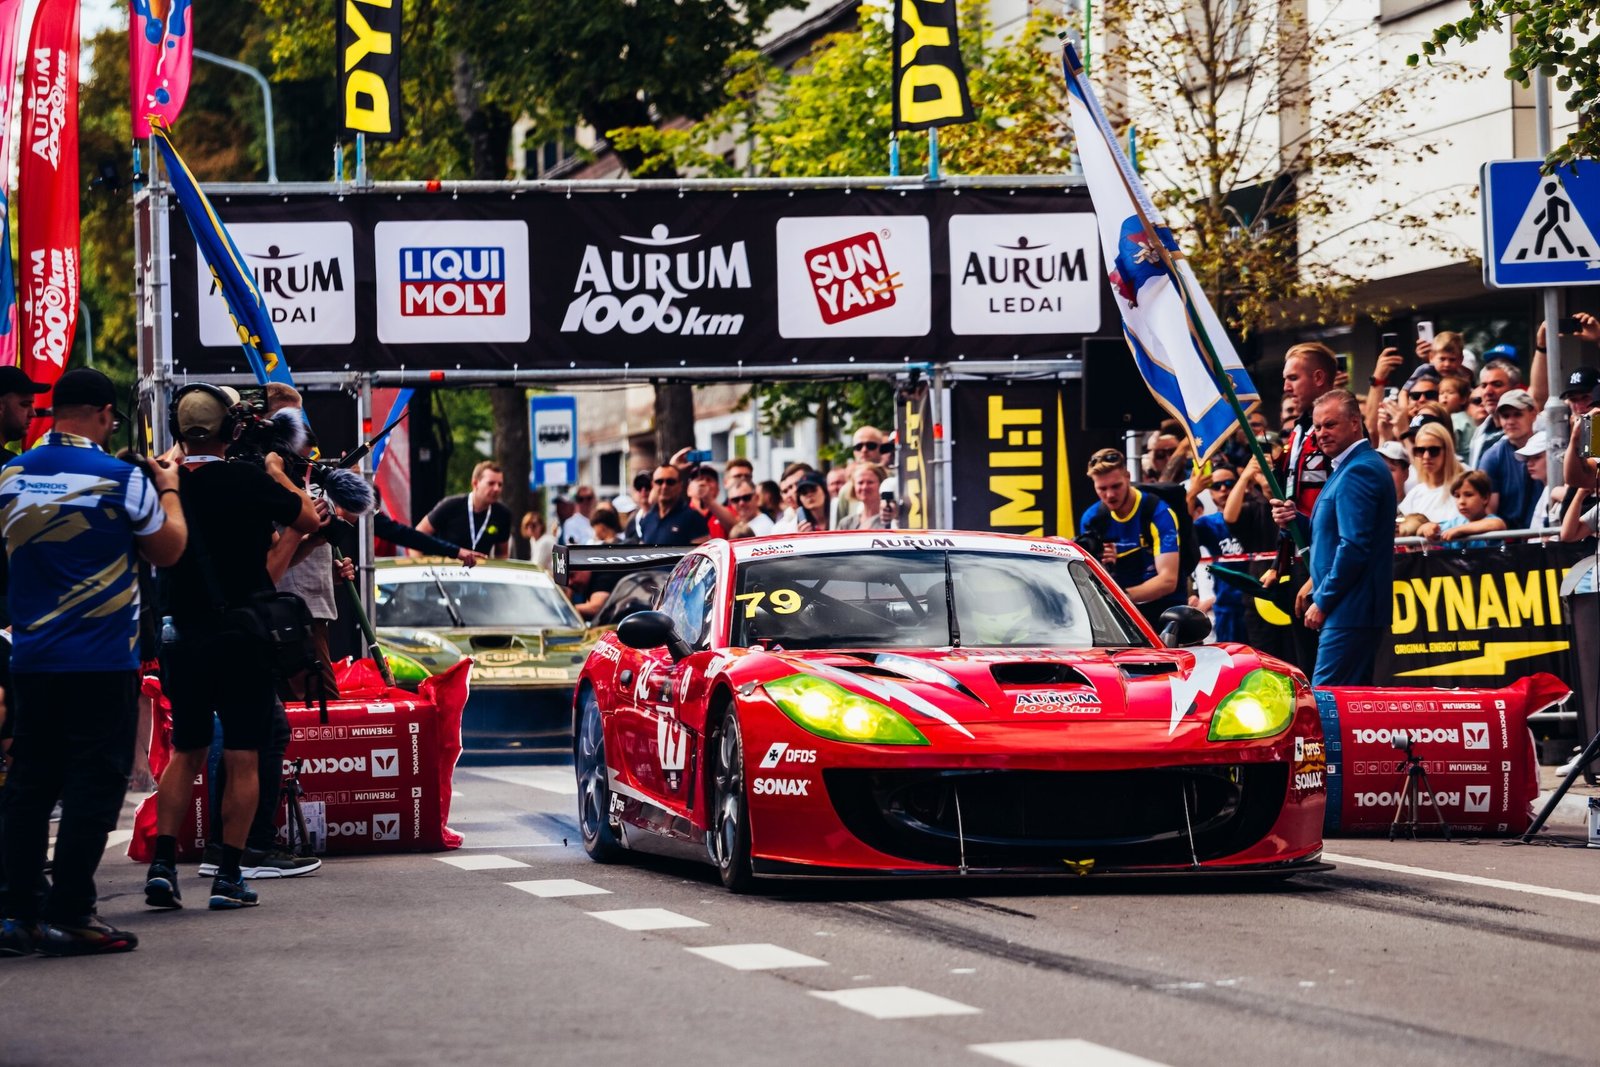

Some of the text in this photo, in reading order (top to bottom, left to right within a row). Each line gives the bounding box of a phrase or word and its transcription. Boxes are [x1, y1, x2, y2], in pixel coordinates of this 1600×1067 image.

[345, 0, 393, 133] DY
[900, 0, 964, 124] DY
[32, 47, 51, 161] AURUM
[405, 249, 501, 281] LIQUI
[573, 241, 752, 298] AURUM
[810, 239, 883, 287] SUN
[961, 247, 1088, 290] AURUM
[209, 258, 344, 300] RUM
[818, 270, 892, 317] YAN
[31, 249, 48, 361] AURUM
[405, 283, 503, 314] MOLY
[989, 296, 1062, 313] LEDAI
[271, 306, 316, 323] DAI
[988, 395, 1044, 537] MI:T
[871, 537, 955, 549] AURUM
[736, 588, 802, 619] 79
[1391, 568, 1570, 634] DYNAMI
[1394, 640, 1480, 655] ORIGINAL ENERGY DRINK
[1017, 693, 1102, 704] AURUM
[1441, 702, 1481, 710] PREMIUM
[351, 726, 394, 736] PREMIUM
[1499, 710, 1508, 749] ROCKWOOL
[411, 734, 419, 776] ROCKWOOL
[786, 749, 817, 763] DFDS
[1449, 763, 1488, 771] PREMIUM
[354, 791, 396, 801] PREMIUM
[753, 778, 810, 795] SONAX
[1295, 771, 1323, 790] SONAX
